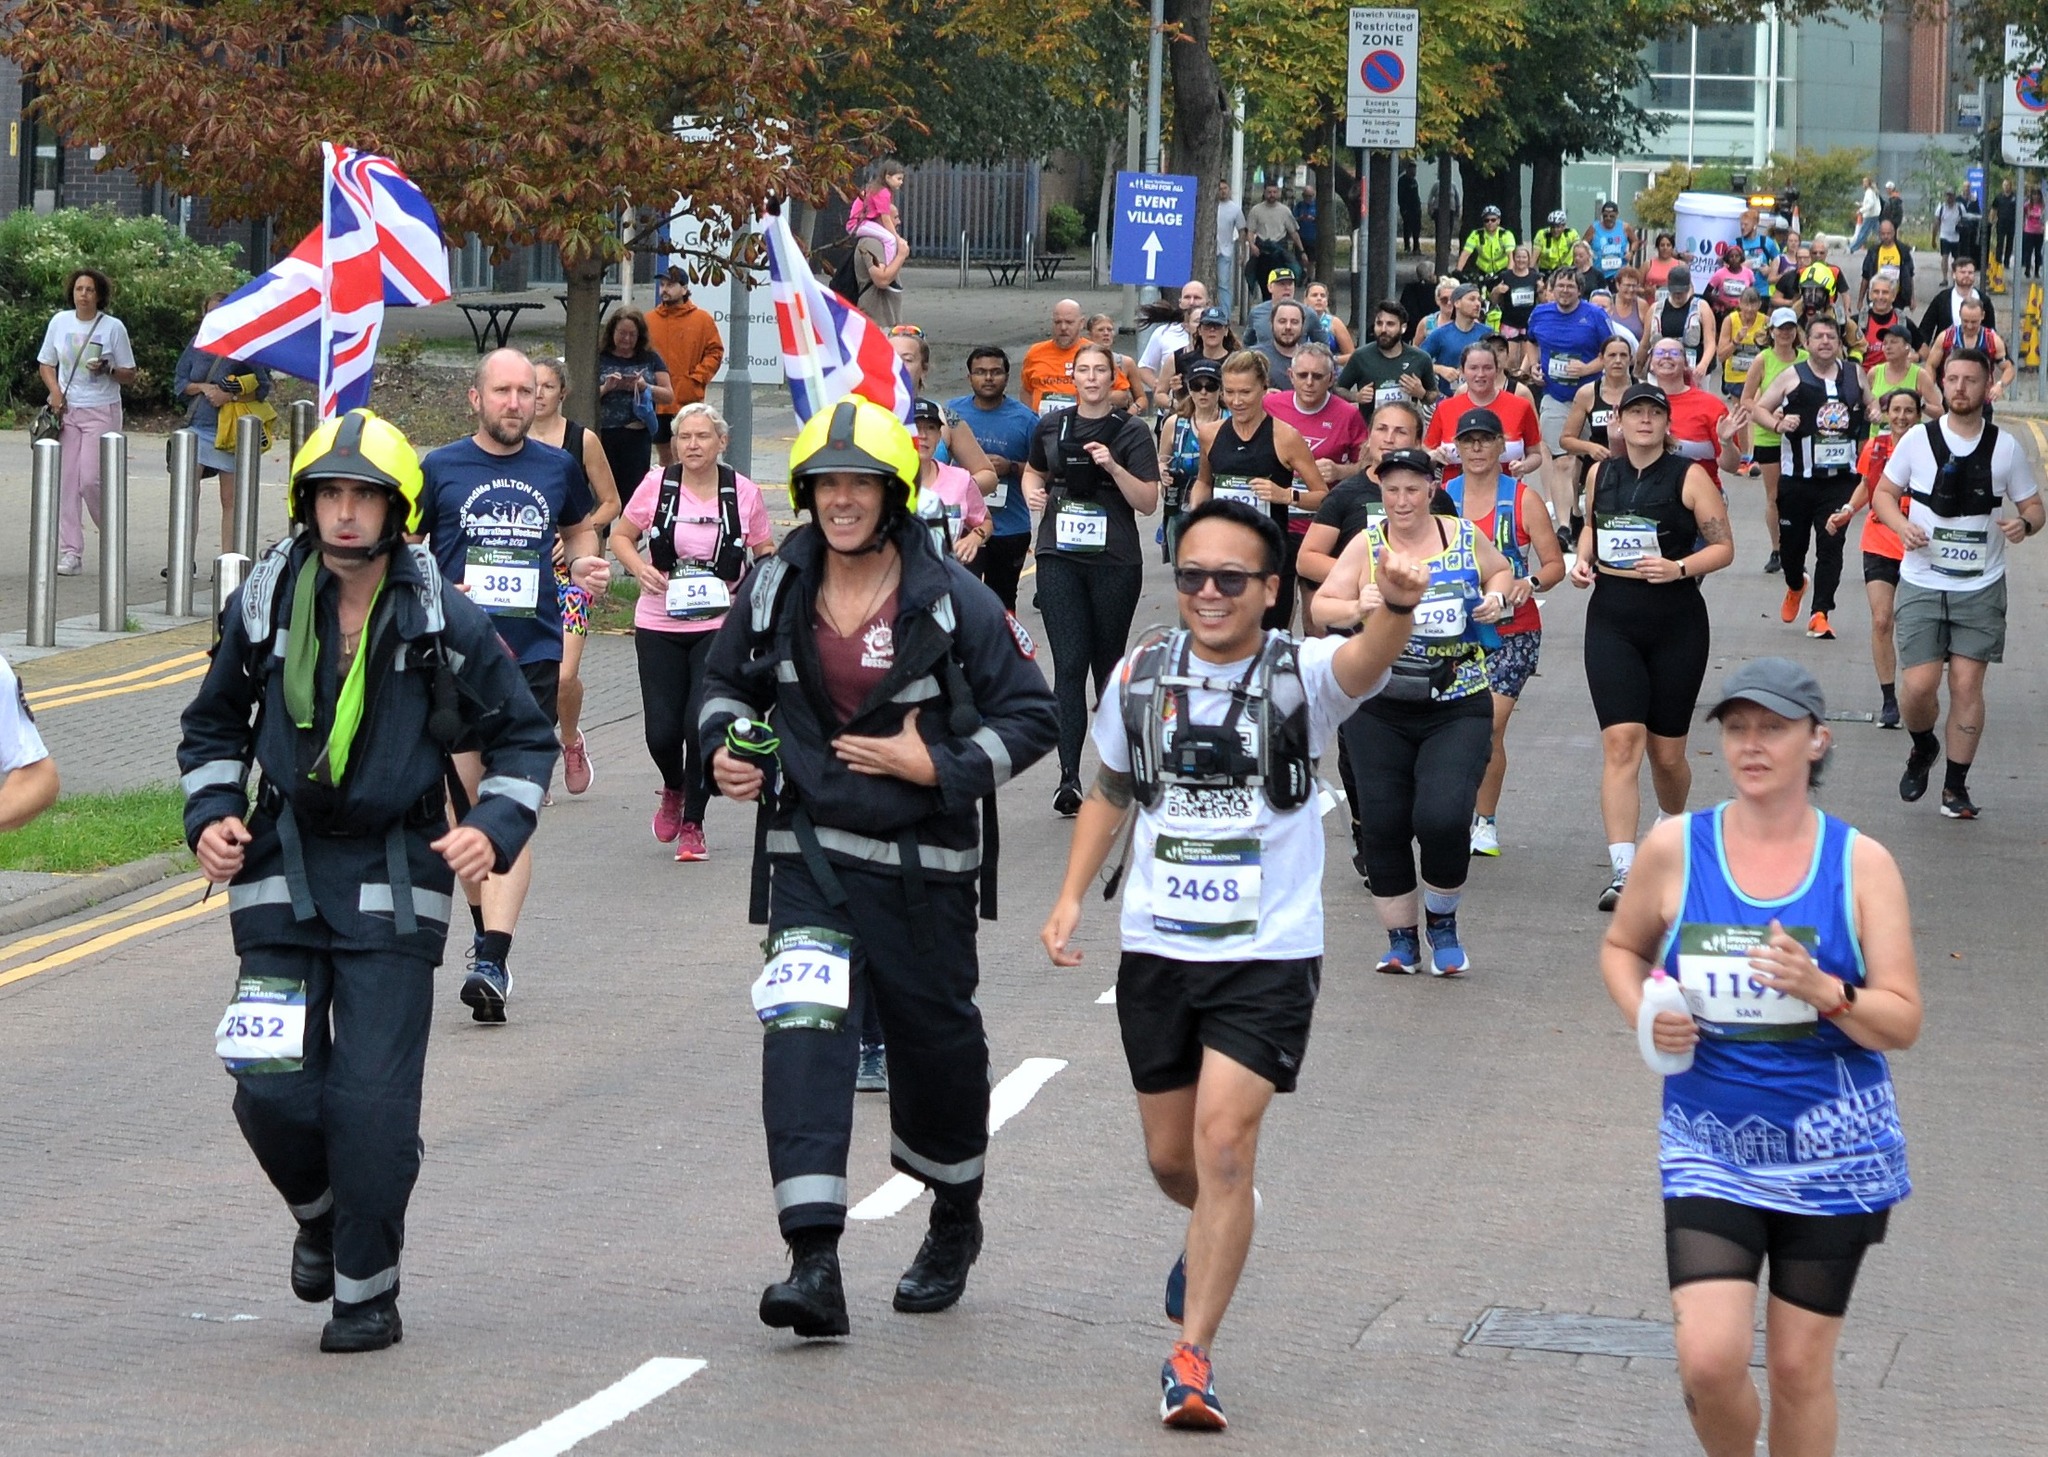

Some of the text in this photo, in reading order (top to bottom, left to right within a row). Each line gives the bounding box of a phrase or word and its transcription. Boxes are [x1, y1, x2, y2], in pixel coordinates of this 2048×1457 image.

[1352, 10, 1415, 20] Ipswich Village
[1355, 21, 1413, 32] Restricted
[1362, 34, 1404, 46] ZONE
[1172, 184, 1184, 192] ALL
[1135, 195, 1178, 209] EVENT
[1127, 210, 1183, 226] VILLAGE
[713, 311, 778, 324] Deeries
[748, 356, 777, 367] Road
[1384, 391, 1403, 401] 455
[1825, 448, 1845, 457] 229
[460, 478, 550, 530] GoFundMe MILTON KEYNES
[477, 527, 511, 536] Marathon
[512, 528, 542, 539] Weekend
[1061, 520, 1096, 534] 1192
[1610, 537, 1642, 550] 263
[1941, 547, 1978, 561] 2206
[483, 574, 522, 593] 383
[687, 584, 708, 598] 54
[1166, 875, 1240, 902] 2468
[766, 963, 831, 987] 2574
[1706, 972, 1788, 999] 119
[1735, 1008, 1763, 1018] SAM
[225, 1015, 285, 1038] 2552
